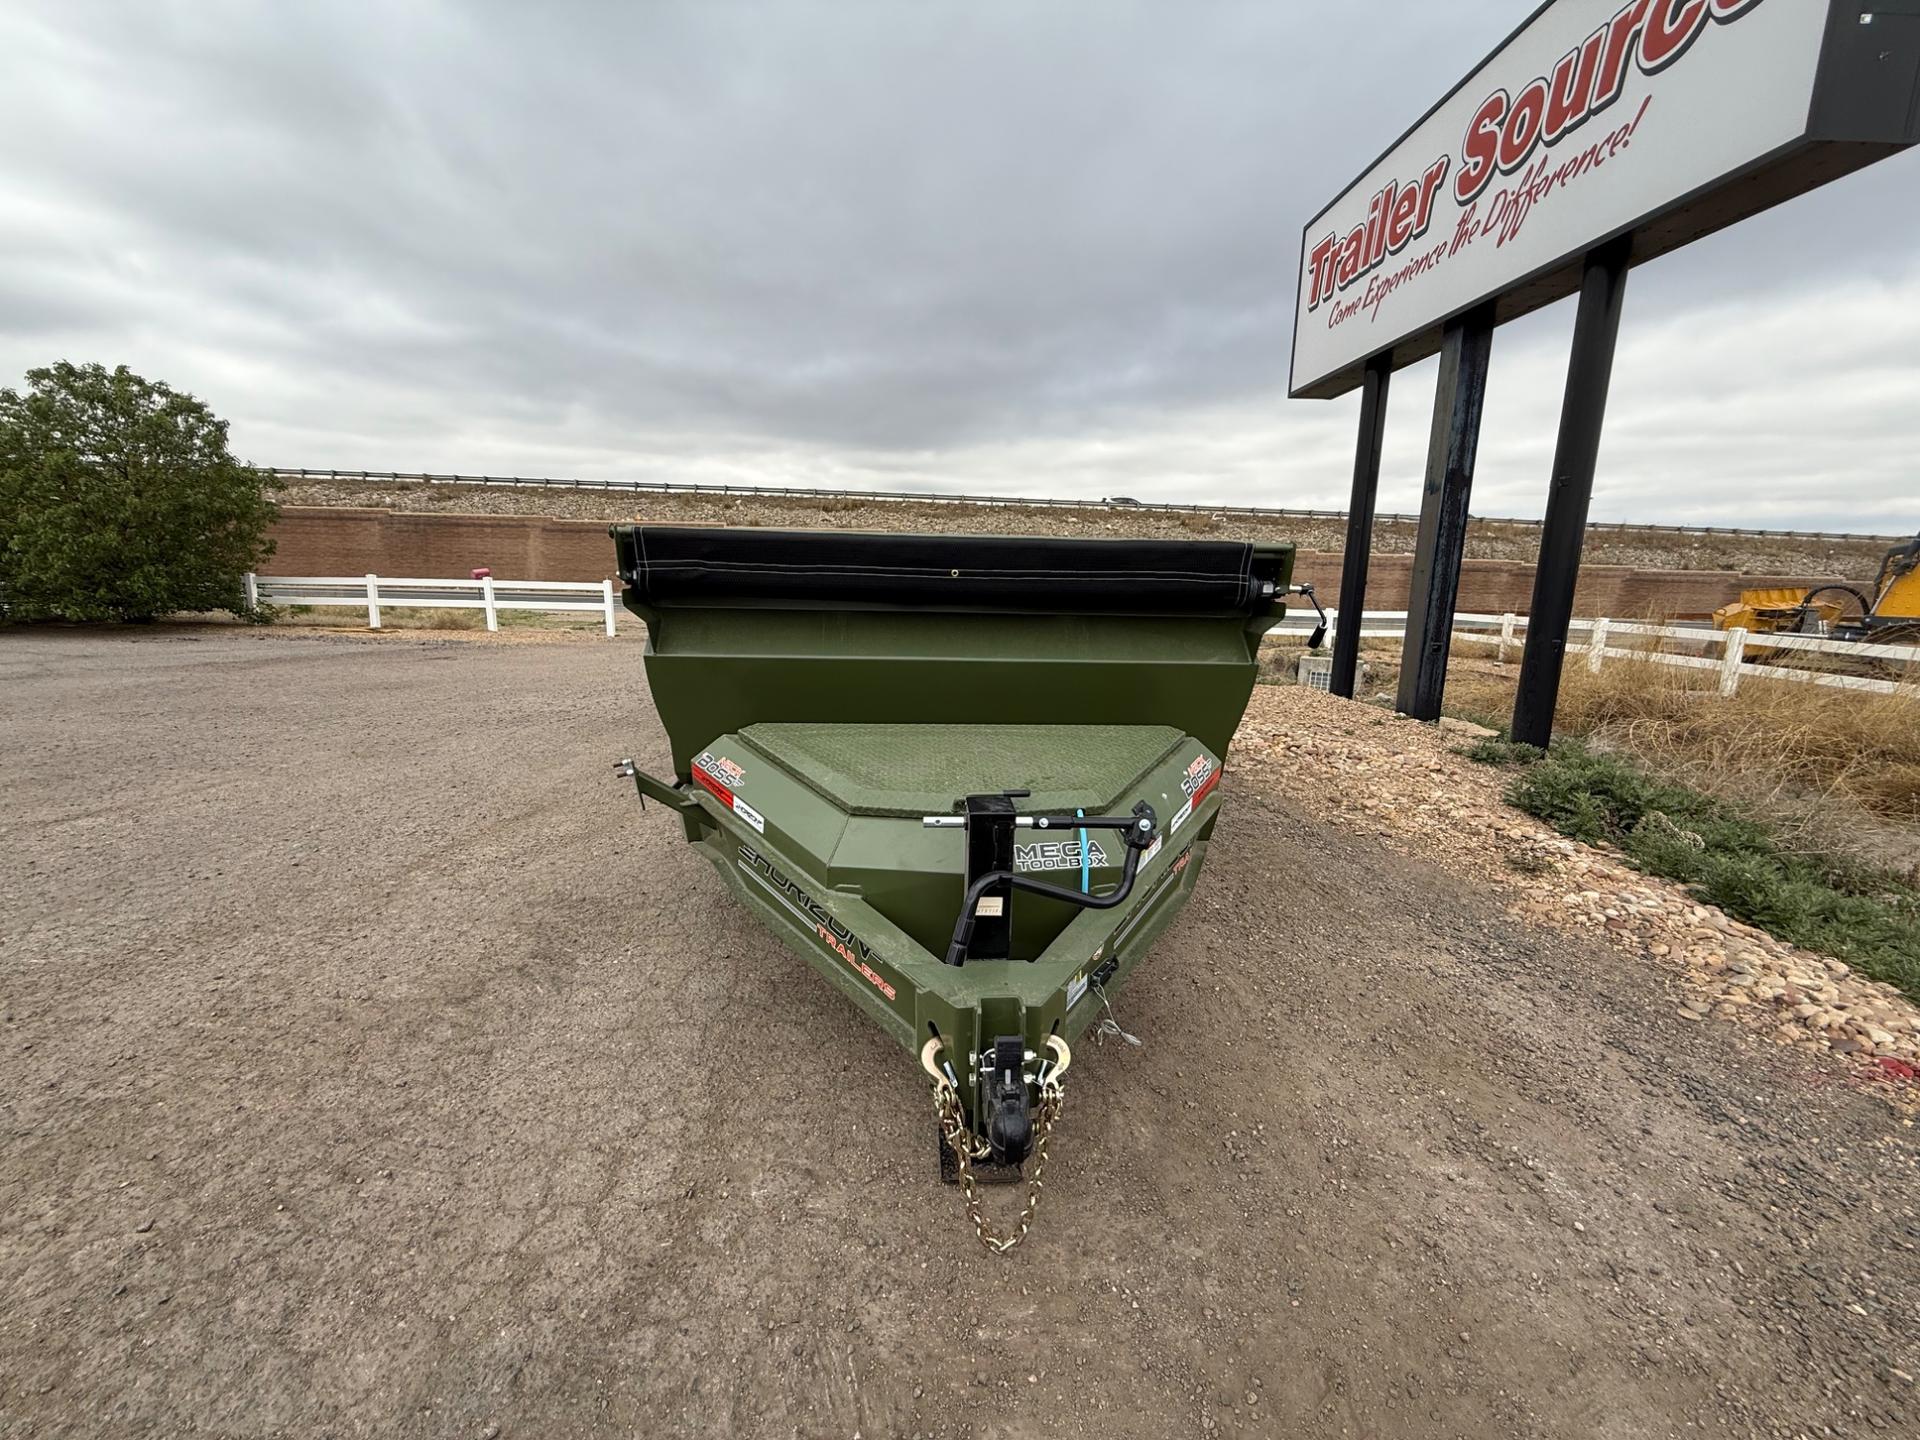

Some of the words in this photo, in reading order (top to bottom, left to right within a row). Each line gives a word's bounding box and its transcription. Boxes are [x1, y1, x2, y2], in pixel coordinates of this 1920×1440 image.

[1308, 153, 1450, 313] Trailer
[1454, 0, 1766, 206] Sourc
[1328, 295, 1363, 329] Come
[1361, 241, 1448, 323] Experience
[1481, 95, 1652, 248] Difference!
[1014, 840, 1107, 861] MEGA
[816, 923, 896, 1001] TRAILERS
